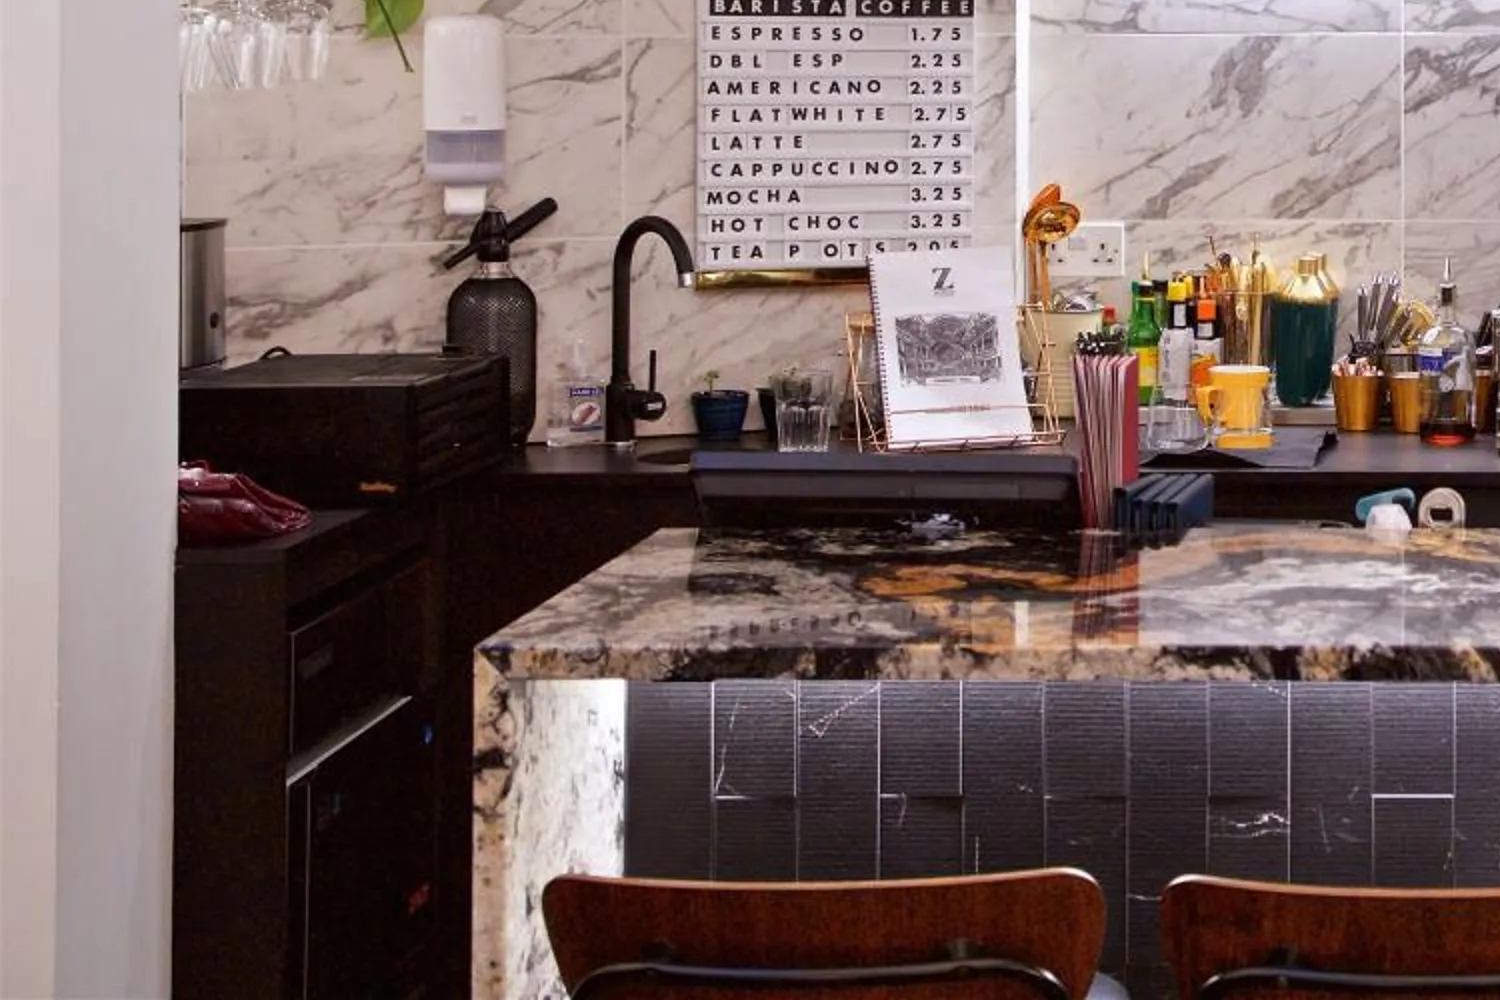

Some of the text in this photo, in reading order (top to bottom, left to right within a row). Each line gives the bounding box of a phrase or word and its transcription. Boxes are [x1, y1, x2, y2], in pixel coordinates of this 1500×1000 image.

[860, 0, 971, 14] COFFEE
[711, 26, 961, 42] ESPRESSO 1.75
[710, 53, 961, 69] DBL ESP 2.25
[707, 79, 961, 95] AMERICANO 2.25
[914, 107, 966, 121] 2.75
[711, 134, 961, 151] LATTE 2.75
[711, 160, 962, 177] CAPPUCCINO 2.75
[707, 187, 962, 205] MOCHA 3.25
[711, 213, 961, 233] HOT CHOC 3.25
[711, 245, 764, 260] TEA
[931, 267, 955, 291] Z
